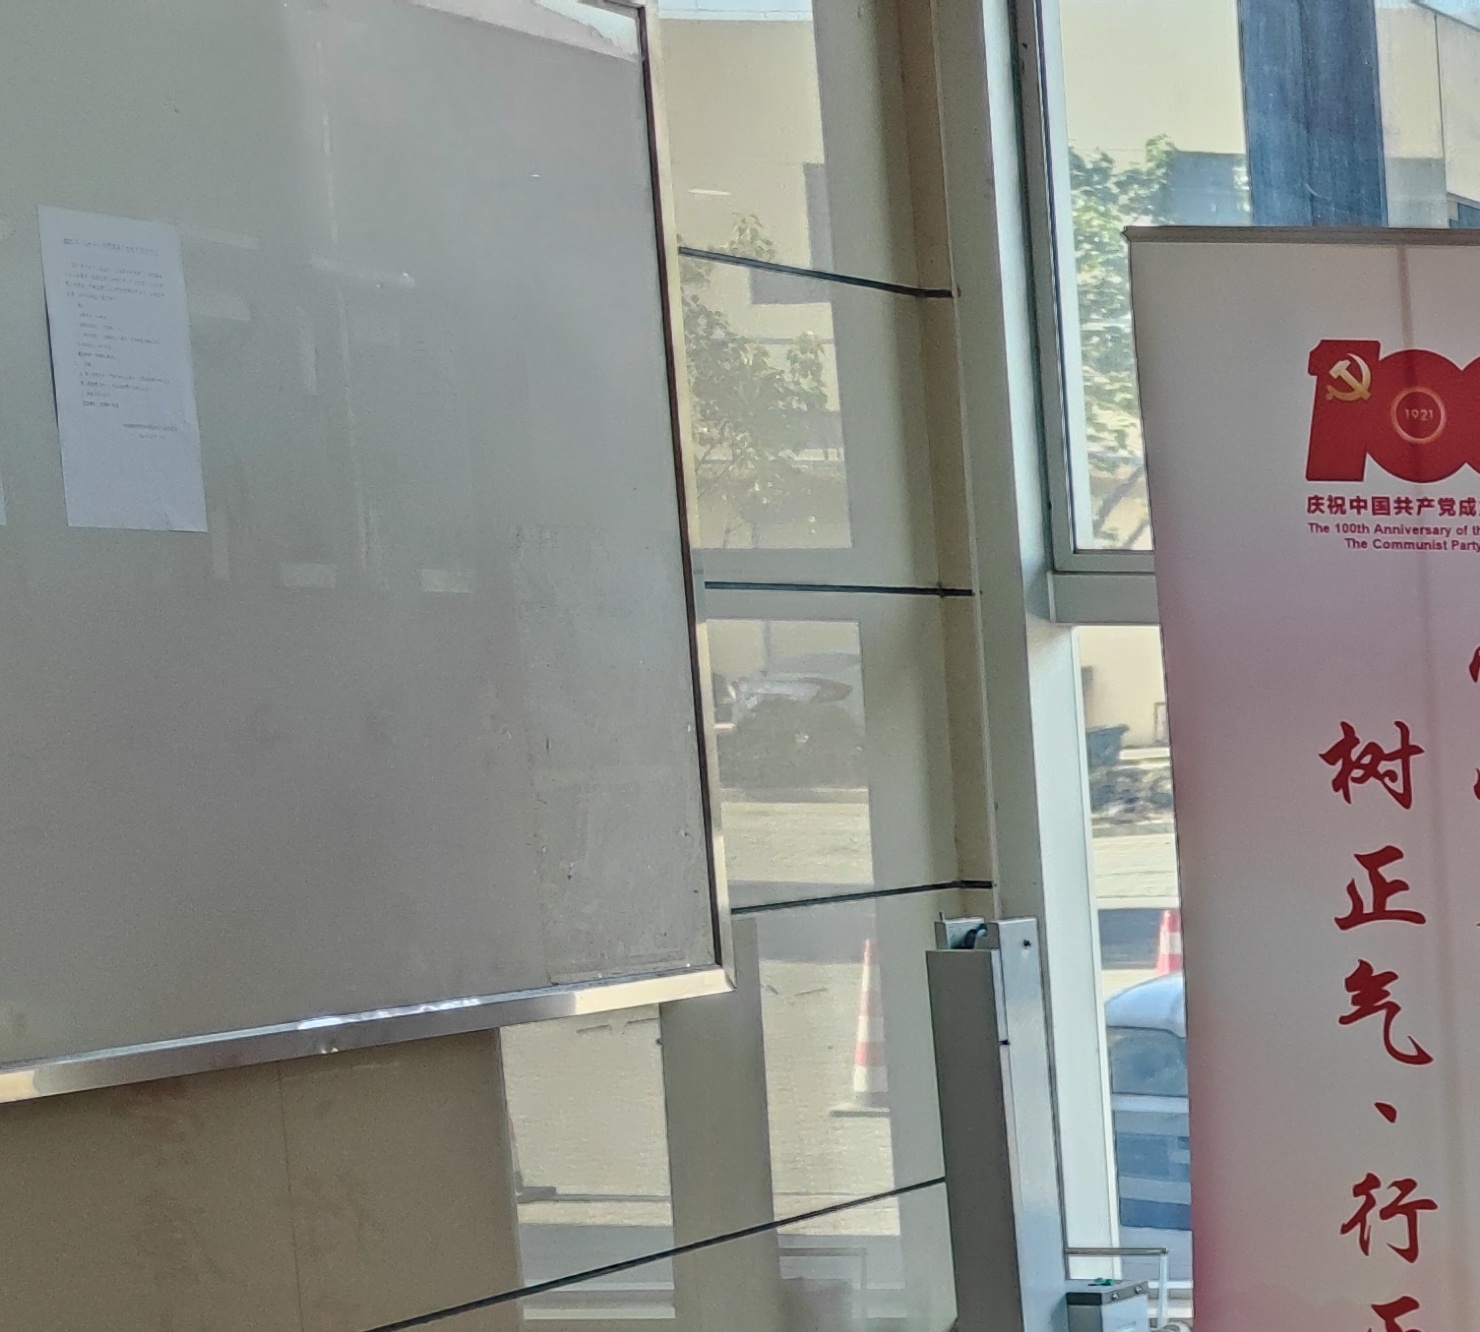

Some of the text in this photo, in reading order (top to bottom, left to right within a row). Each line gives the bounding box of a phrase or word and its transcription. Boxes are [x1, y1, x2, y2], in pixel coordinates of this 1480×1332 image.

[1404, 408, 1434, 422] 1921
[1308, 522, 1331, 534] The
[1335, 522, 1370, 535] 100th
[1374, 523, 1451, 538] Anniversary
[1456, 525, 1468, 536] of
[1345, 538, 1367, 550] The
[1372, 538, 1448, 551] Communist
